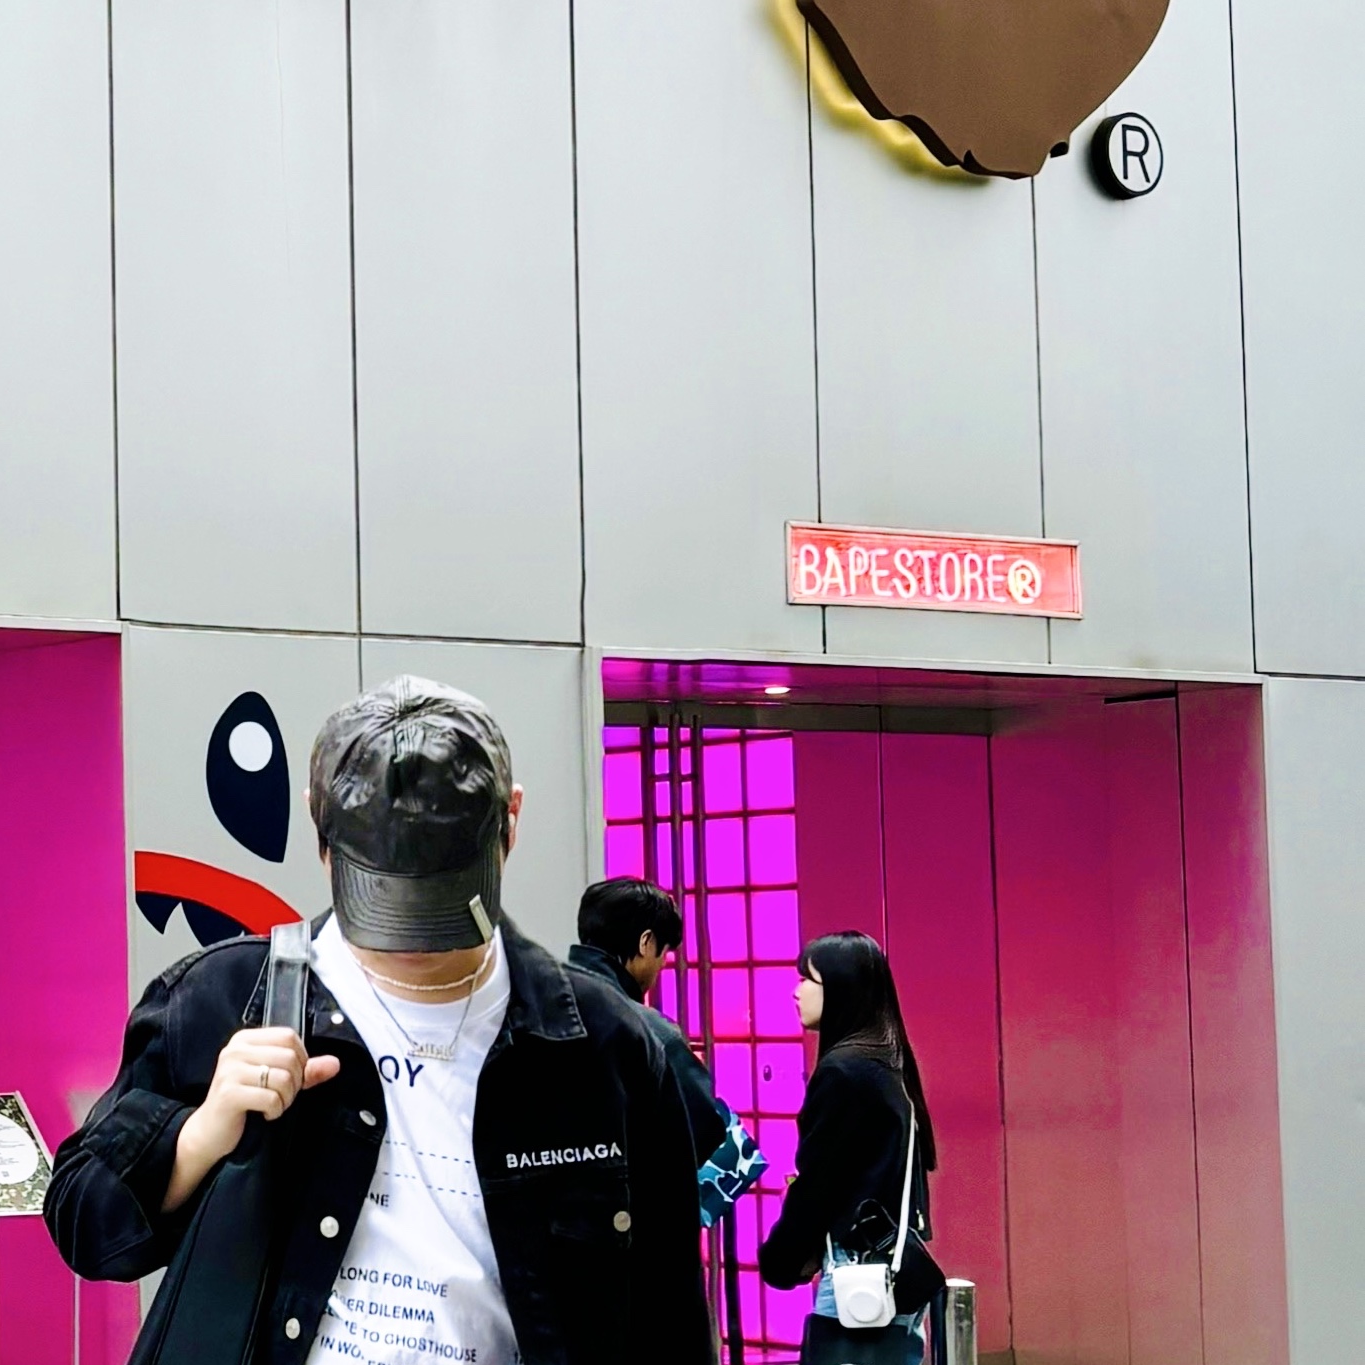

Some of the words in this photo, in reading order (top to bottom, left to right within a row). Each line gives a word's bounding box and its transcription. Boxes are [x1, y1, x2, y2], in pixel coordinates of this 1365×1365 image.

[378, 1055, 424, 1087] OY
[505, 1141, 623, 1169] BALENCIAGA
[339, 1266, 380, 1284] LONG
[383, 1271, 413, 1290] FOR
[416, 1277, 449, 1298] LOVE
[368, 1301, 435, 1325] DILEMMA
[361, 1327, 380, 1343] TO
[384, 1332, 477, 1364] GHOSTHOUSE
